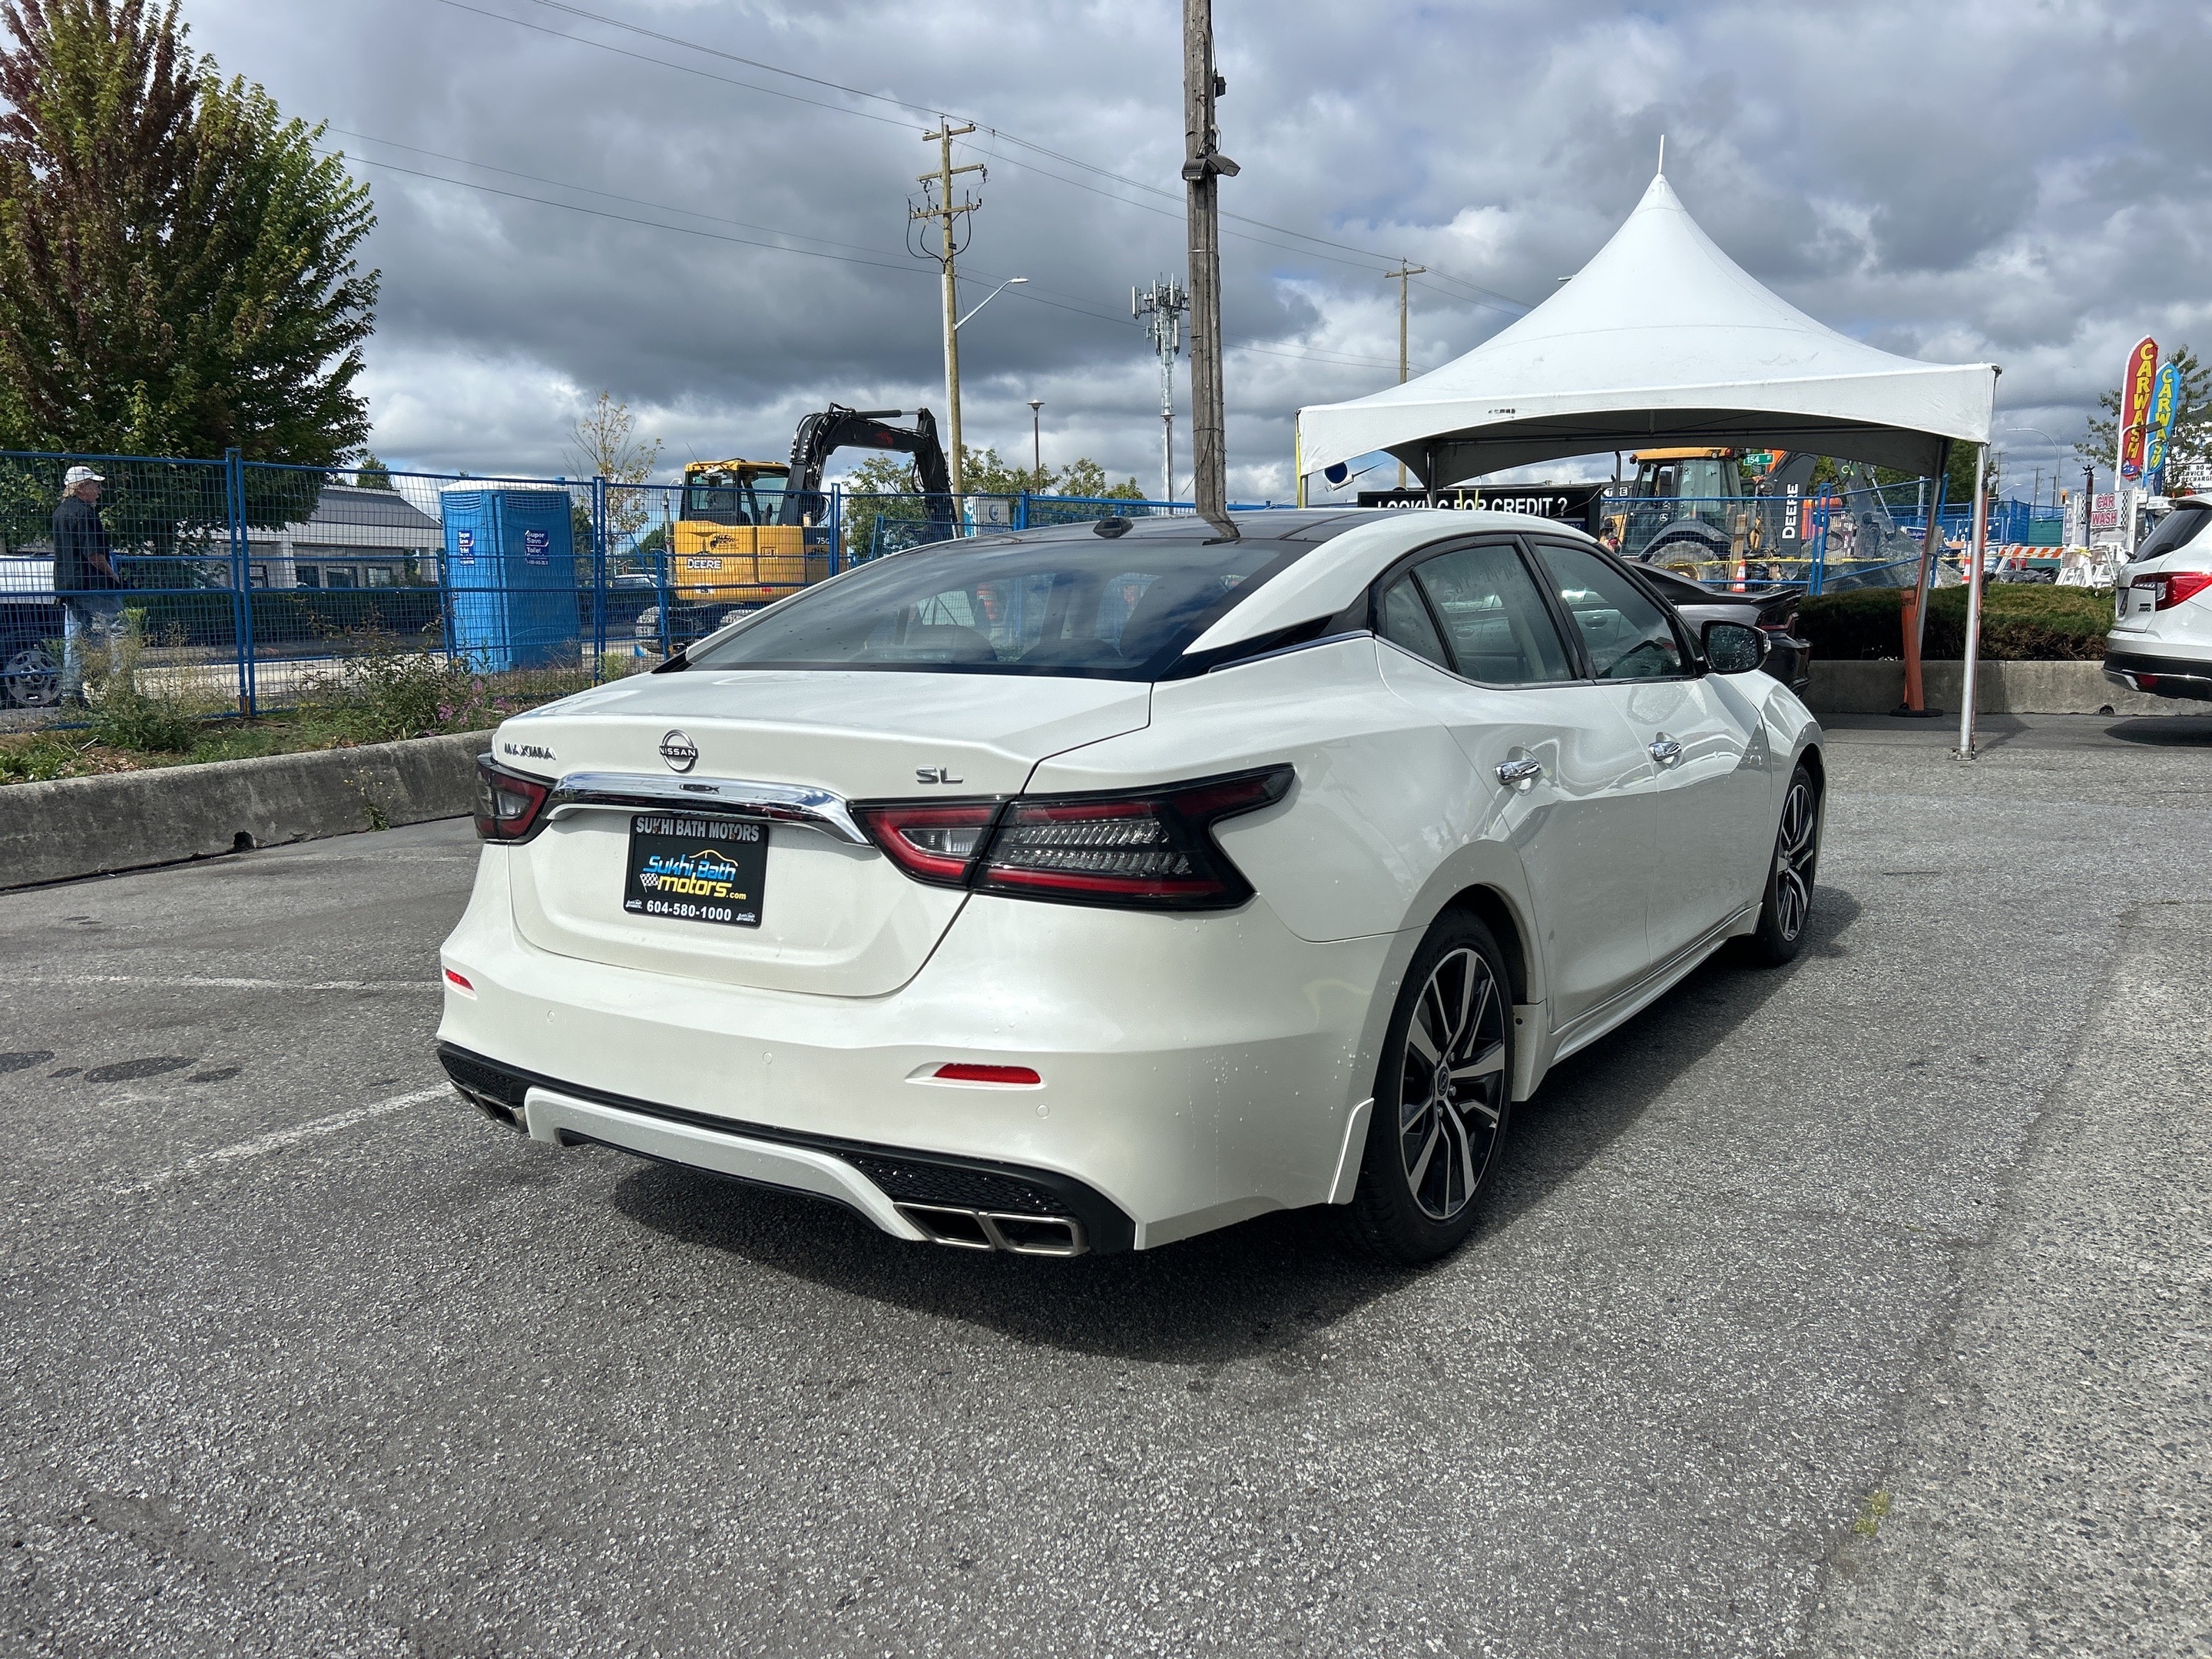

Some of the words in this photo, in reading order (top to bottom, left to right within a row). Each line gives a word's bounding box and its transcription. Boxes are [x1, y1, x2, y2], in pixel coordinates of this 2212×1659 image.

[1747, 455, 1760, 464] 154
[1492, 498, 1553, 517] CREDIT
[2096, 492, 2115, 511] CAR
[1782, 483, 1799, 539] DEERE
[2091, 510, 2118, 528] WASH
[687, 558, 722, 570] DEERE
[504, 742, 556, 760] MAXIMA
[659, 746, 697, 757] NISSAN
[916, 767, 964, 784] SL
[636, 816, 674, 835] SUKHI
[676, 819, 706, 838] BATH
[709, 821, 760, 842] MOTORS
[643, 854, 695, 876] Sukhi
[696, 860, 737, 881] Bath
[646, 899, 732, 921] 604-580-1000
